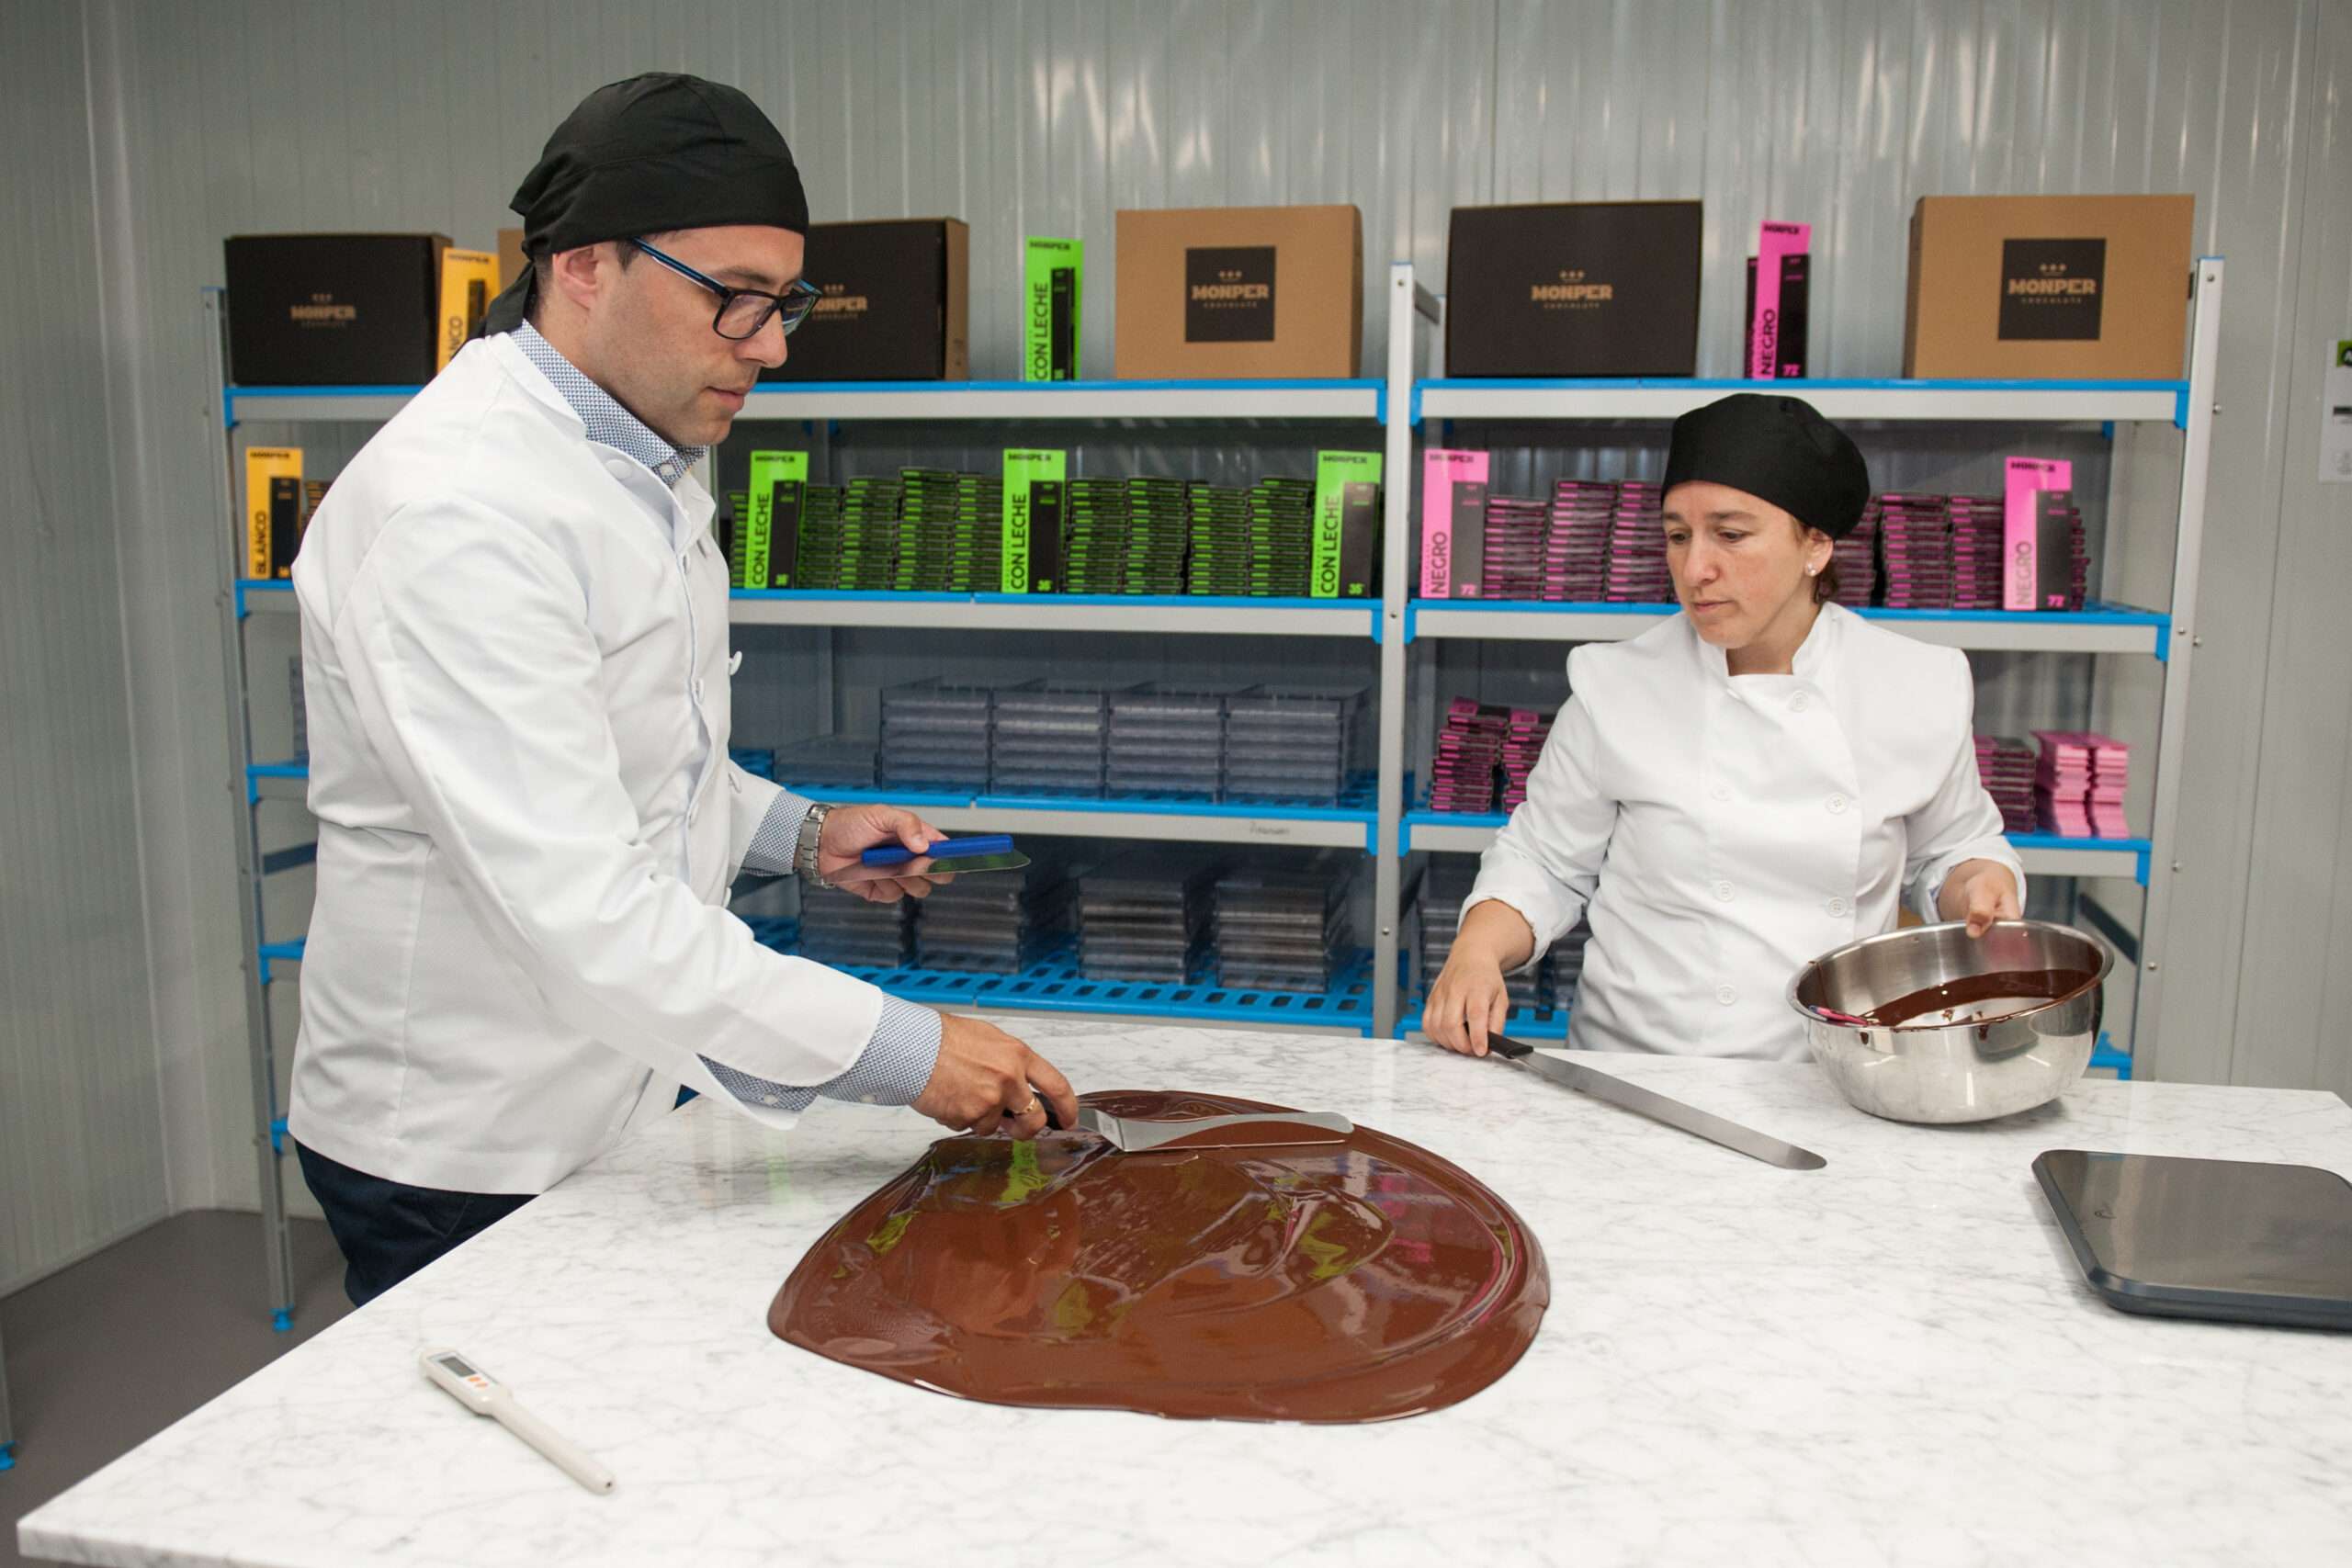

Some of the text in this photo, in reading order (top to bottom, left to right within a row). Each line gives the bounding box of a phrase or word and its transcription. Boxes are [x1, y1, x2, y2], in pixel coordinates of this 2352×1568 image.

[811, 297, 868, 312] ONPER
[1192, 284, 1270, 300] MONPER
[1531, 284, 1613, 300] MONPER
[2007, 278, 2097, 295] MONPER
[1033, 282, 1049, 381] CON LECHE
[1760, 309, 1776, 376] NEGRO
[752, 492, 770, 585] CON LECHE
[1011, 493, 1026, 590] CON LECHE
[1320, 495, 1340, 594] CON LECHE
[1430, 531, 1448, 594] NEGRO
[2015, 540, 2032, 606] NEGRO
